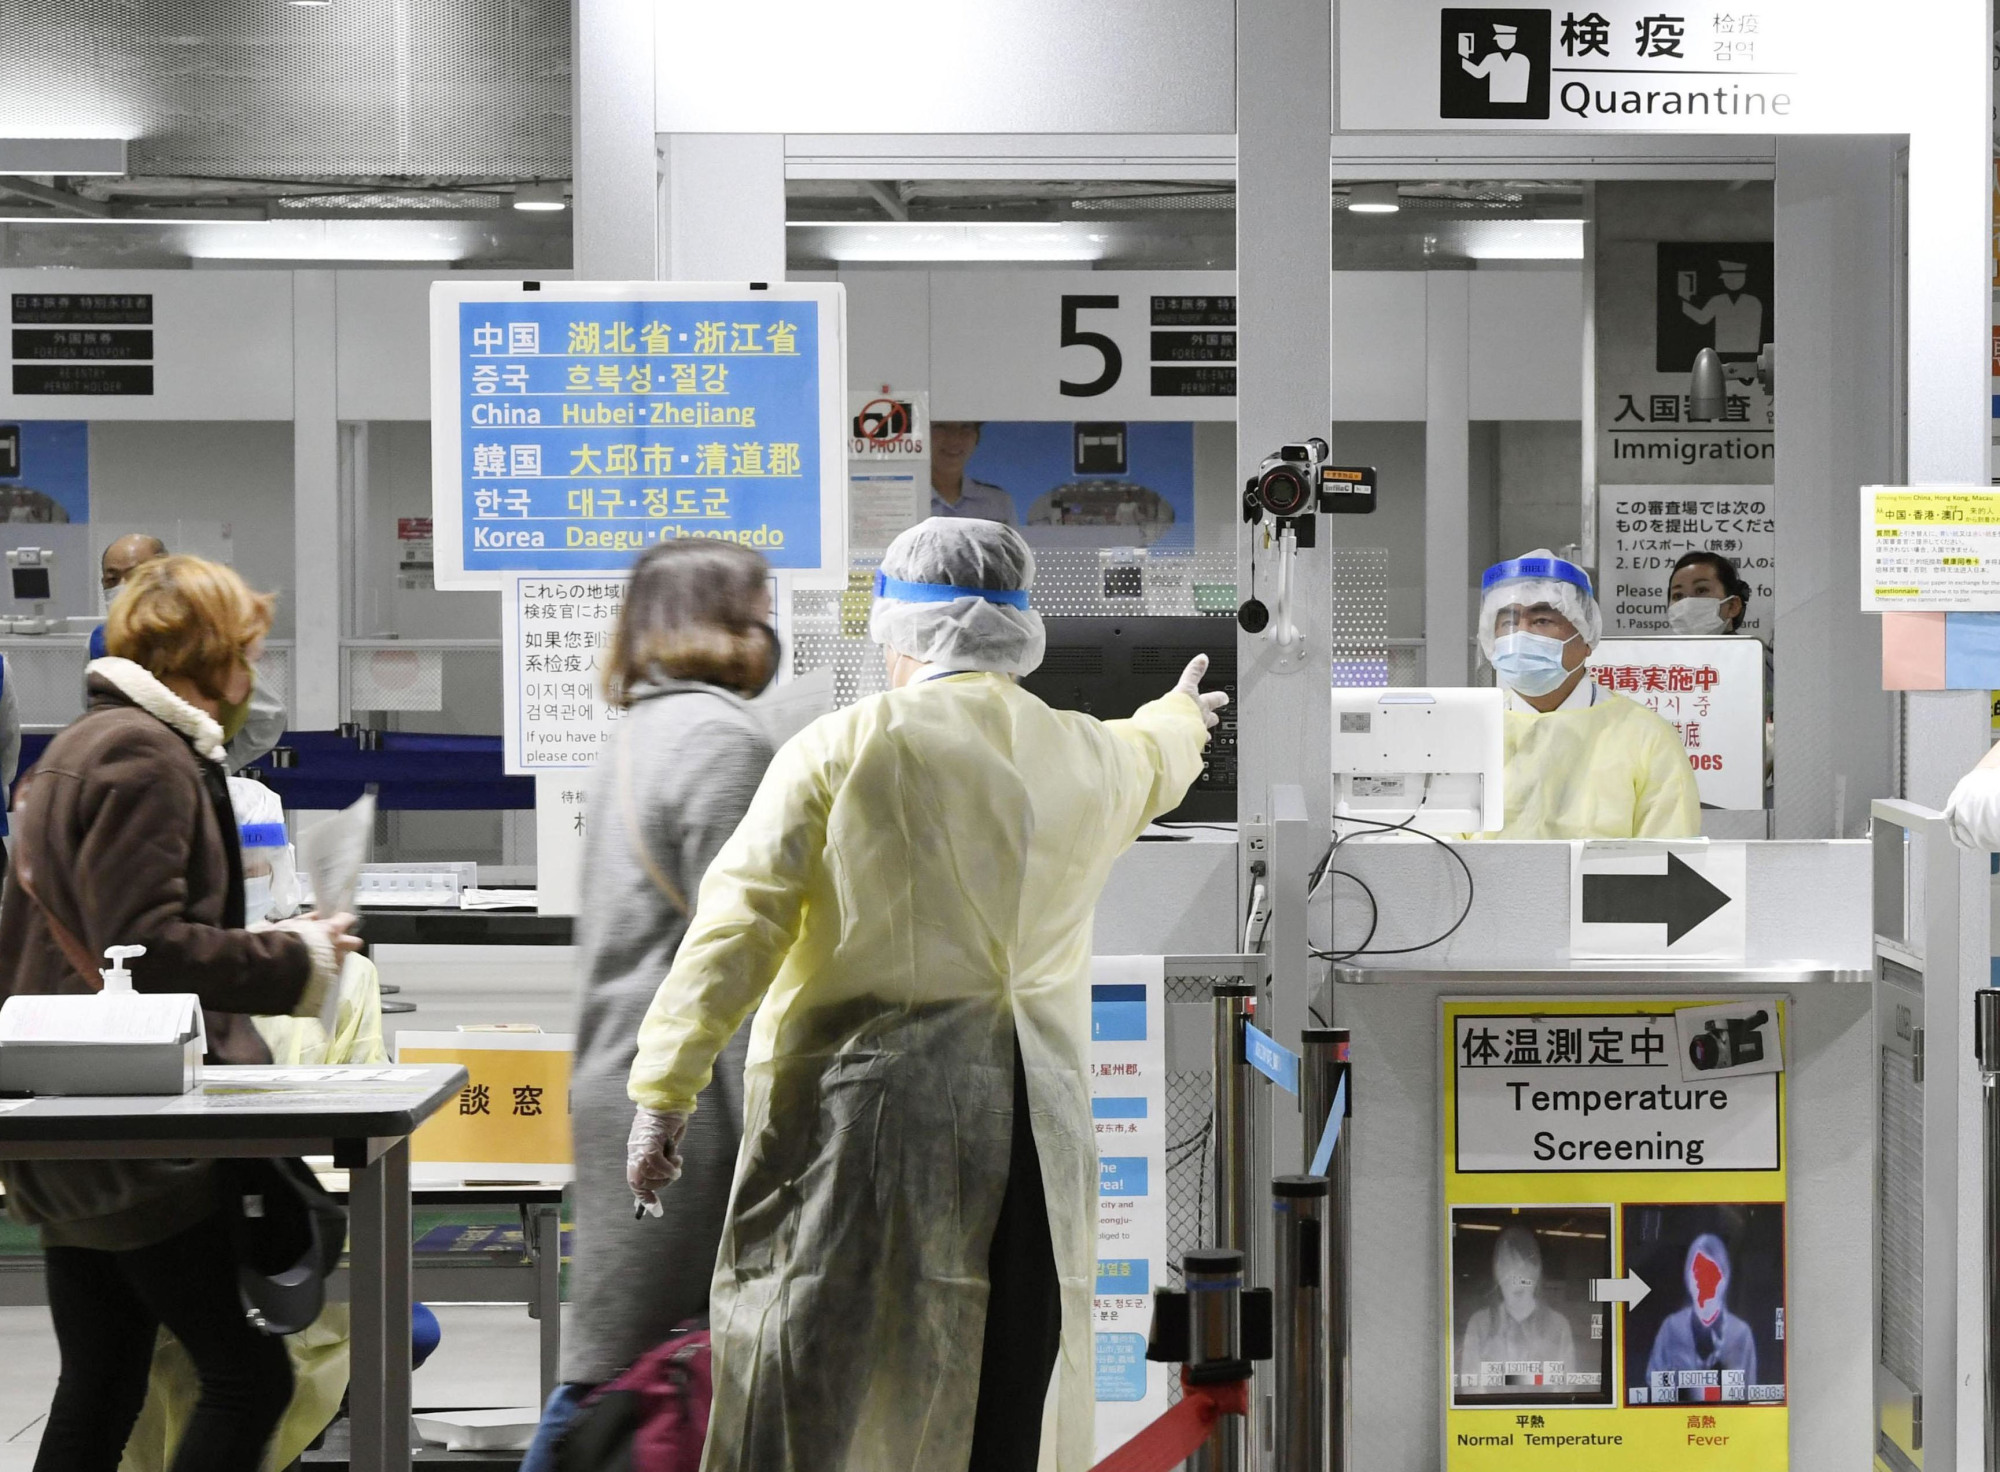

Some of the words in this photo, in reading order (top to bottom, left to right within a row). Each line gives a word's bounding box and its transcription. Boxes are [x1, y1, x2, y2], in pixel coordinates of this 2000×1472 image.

[1713, 13, 1760, 34] 检疫
[1560, 12, 1684, 58] 検疫
[1713, 41, 1754, 61] 검역
[1560, 82, 1791, 118] Quarantine
[473, 321, 540, 355] 中国
[1059, 294, 1123, 397] 5
[471, 402, 541, 425] China
[473, 443, 542, 476] 韓国
[1614, 438, 1775, 465] Immigration
[473, 488, 532, 518] 한국
[1615, 500, 1766, 516] この審査場では次の
[473, 526, 545, 548] Korea
[1616, 558, 1628, 569] 2.
[1633, 557, 1661, 569] E/D
[1616, 585, 1663, 597] Please
[525, 654, 601, 673] 系检疫人
[526, 683, 593, 700] 이지역에
[526, 704, 593, 721] 검역관에
[526, 731, 535, 742] If
[539, 733, 562, 745] you
[566, 731, 597, 743] have
[526, 750, 568, 764] please
[1462, 1027, 1665, 1065] 体温測定中
[1506, 1082, 1728, 1116] Temperature
[1533, 1131, 1704, 1165] Screening
[1101, 1202, 1116, 1210] city
[1681, 1371, 1718, 1385] ISOTHER
[1515, 1415, 1545, 1428] 平熱
[1687, 1415, 1716, 1428] 高熱
[1457, 1434, 1513, 1446] Normal
[1523, 1434, 1623, 1448] Temperature
[1687, 1435, 1730, 1446] Fever
